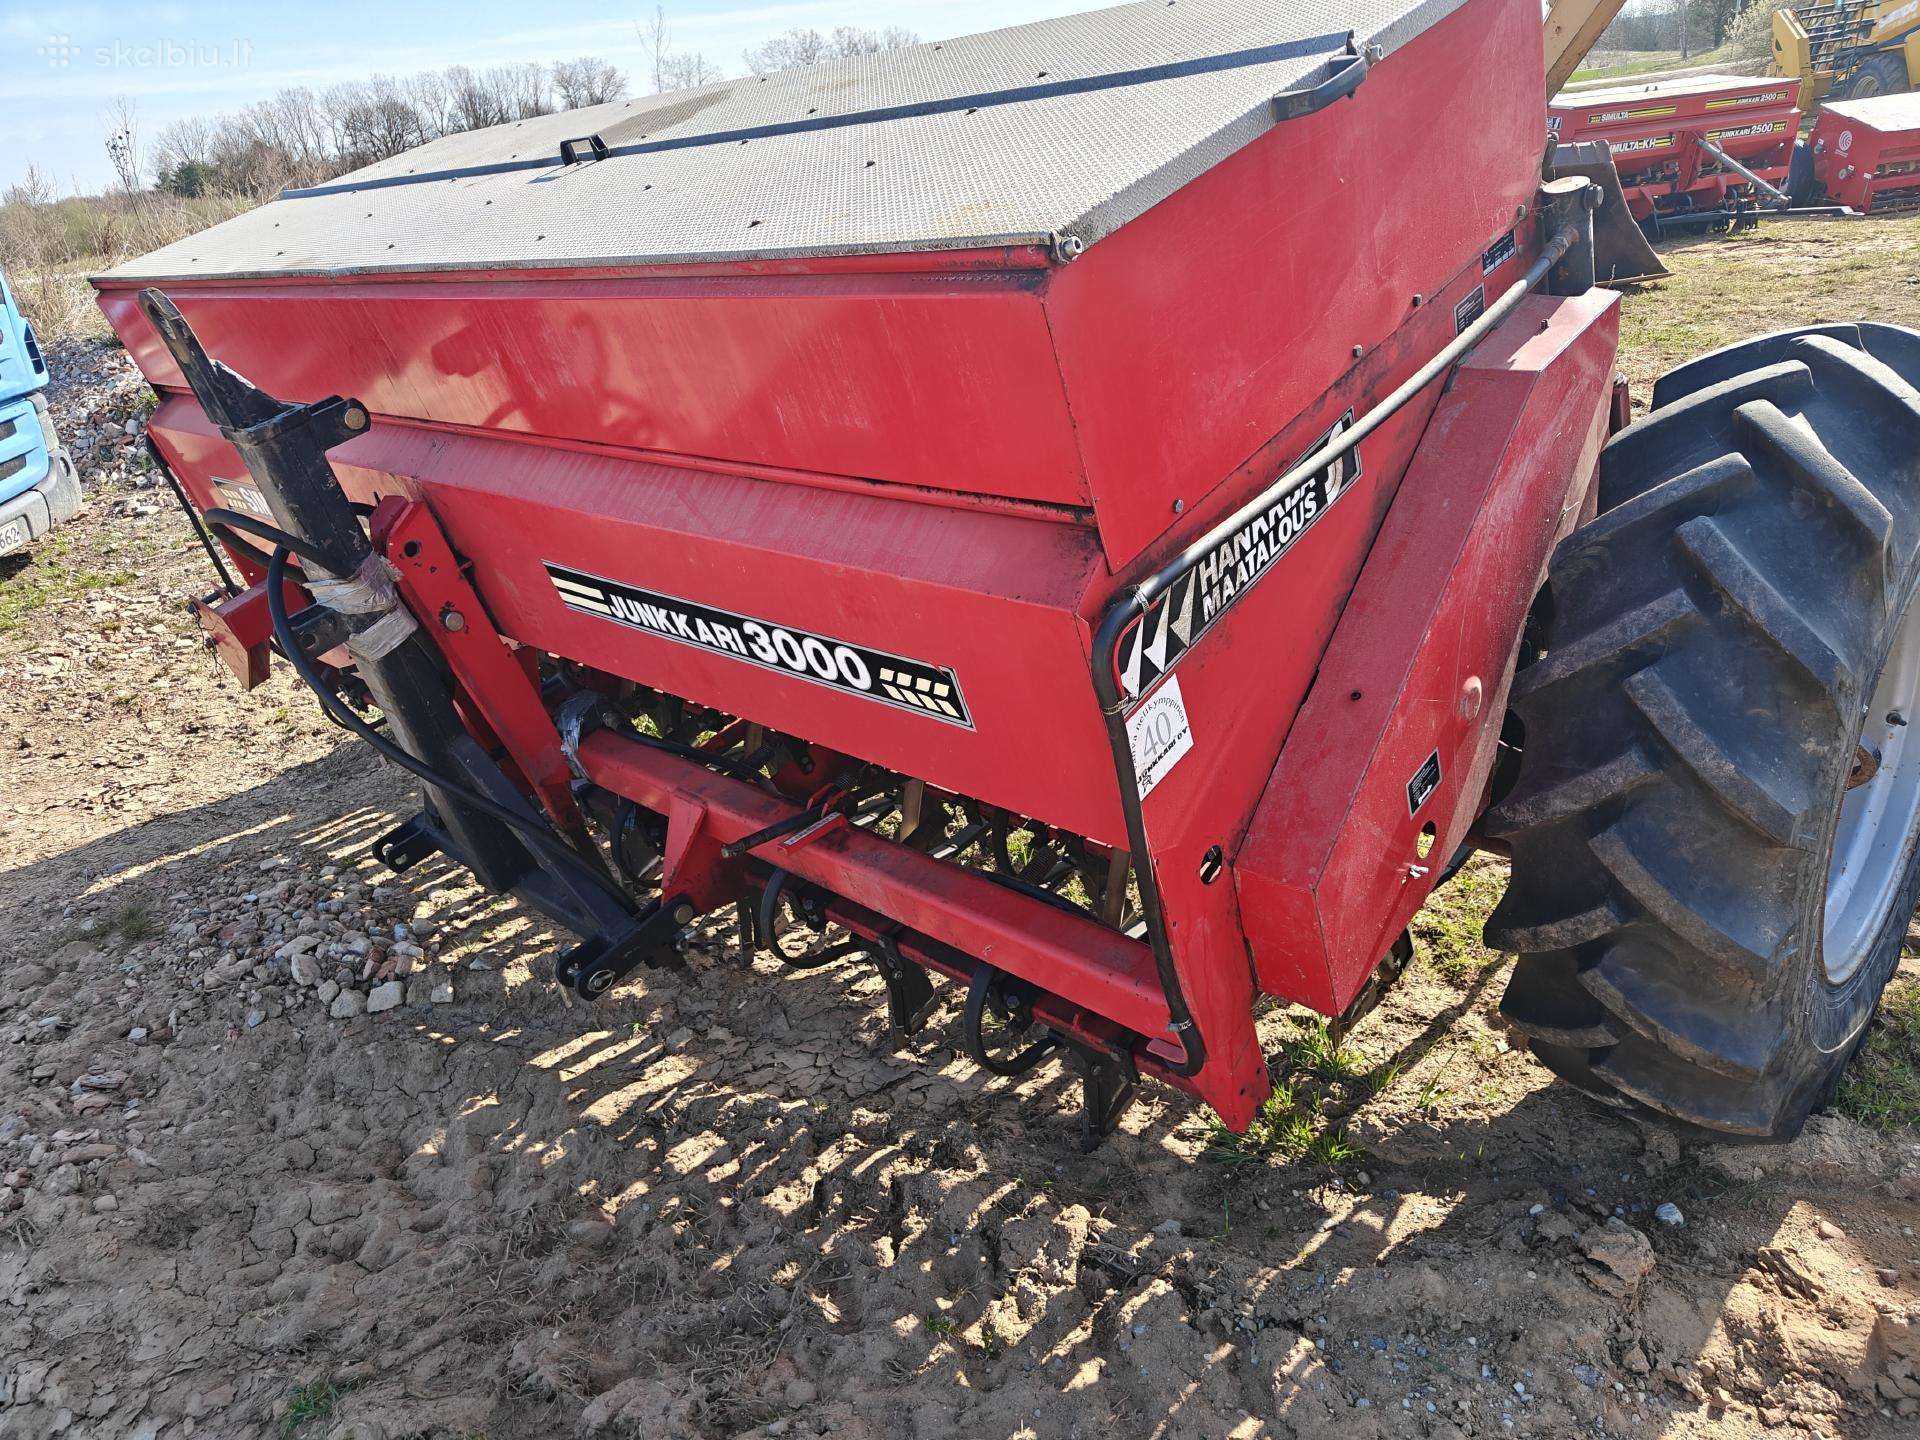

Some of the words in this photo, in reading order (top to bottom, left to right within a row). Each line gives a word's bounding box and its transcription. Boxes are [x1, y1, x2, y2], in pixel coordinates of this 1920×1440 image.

[1601, 111, 1629, 122] SIMULTA
[1760, 93, 1776, 102] 2500
[1720, 129, 1751, 138] JUNKKARI
[1751, 123, 1773, 134] 2500
[1203, 491, 1317, 622] MAATALOUS
[608, 594, 747, 656] JUNKKARI
[743, 620, 872, 690] 3000
[1137, 739, 1177, 784] JUNKKARI
[1177, 726, 1188, 741] OY
[1144, 711, 1171, 757] 40
